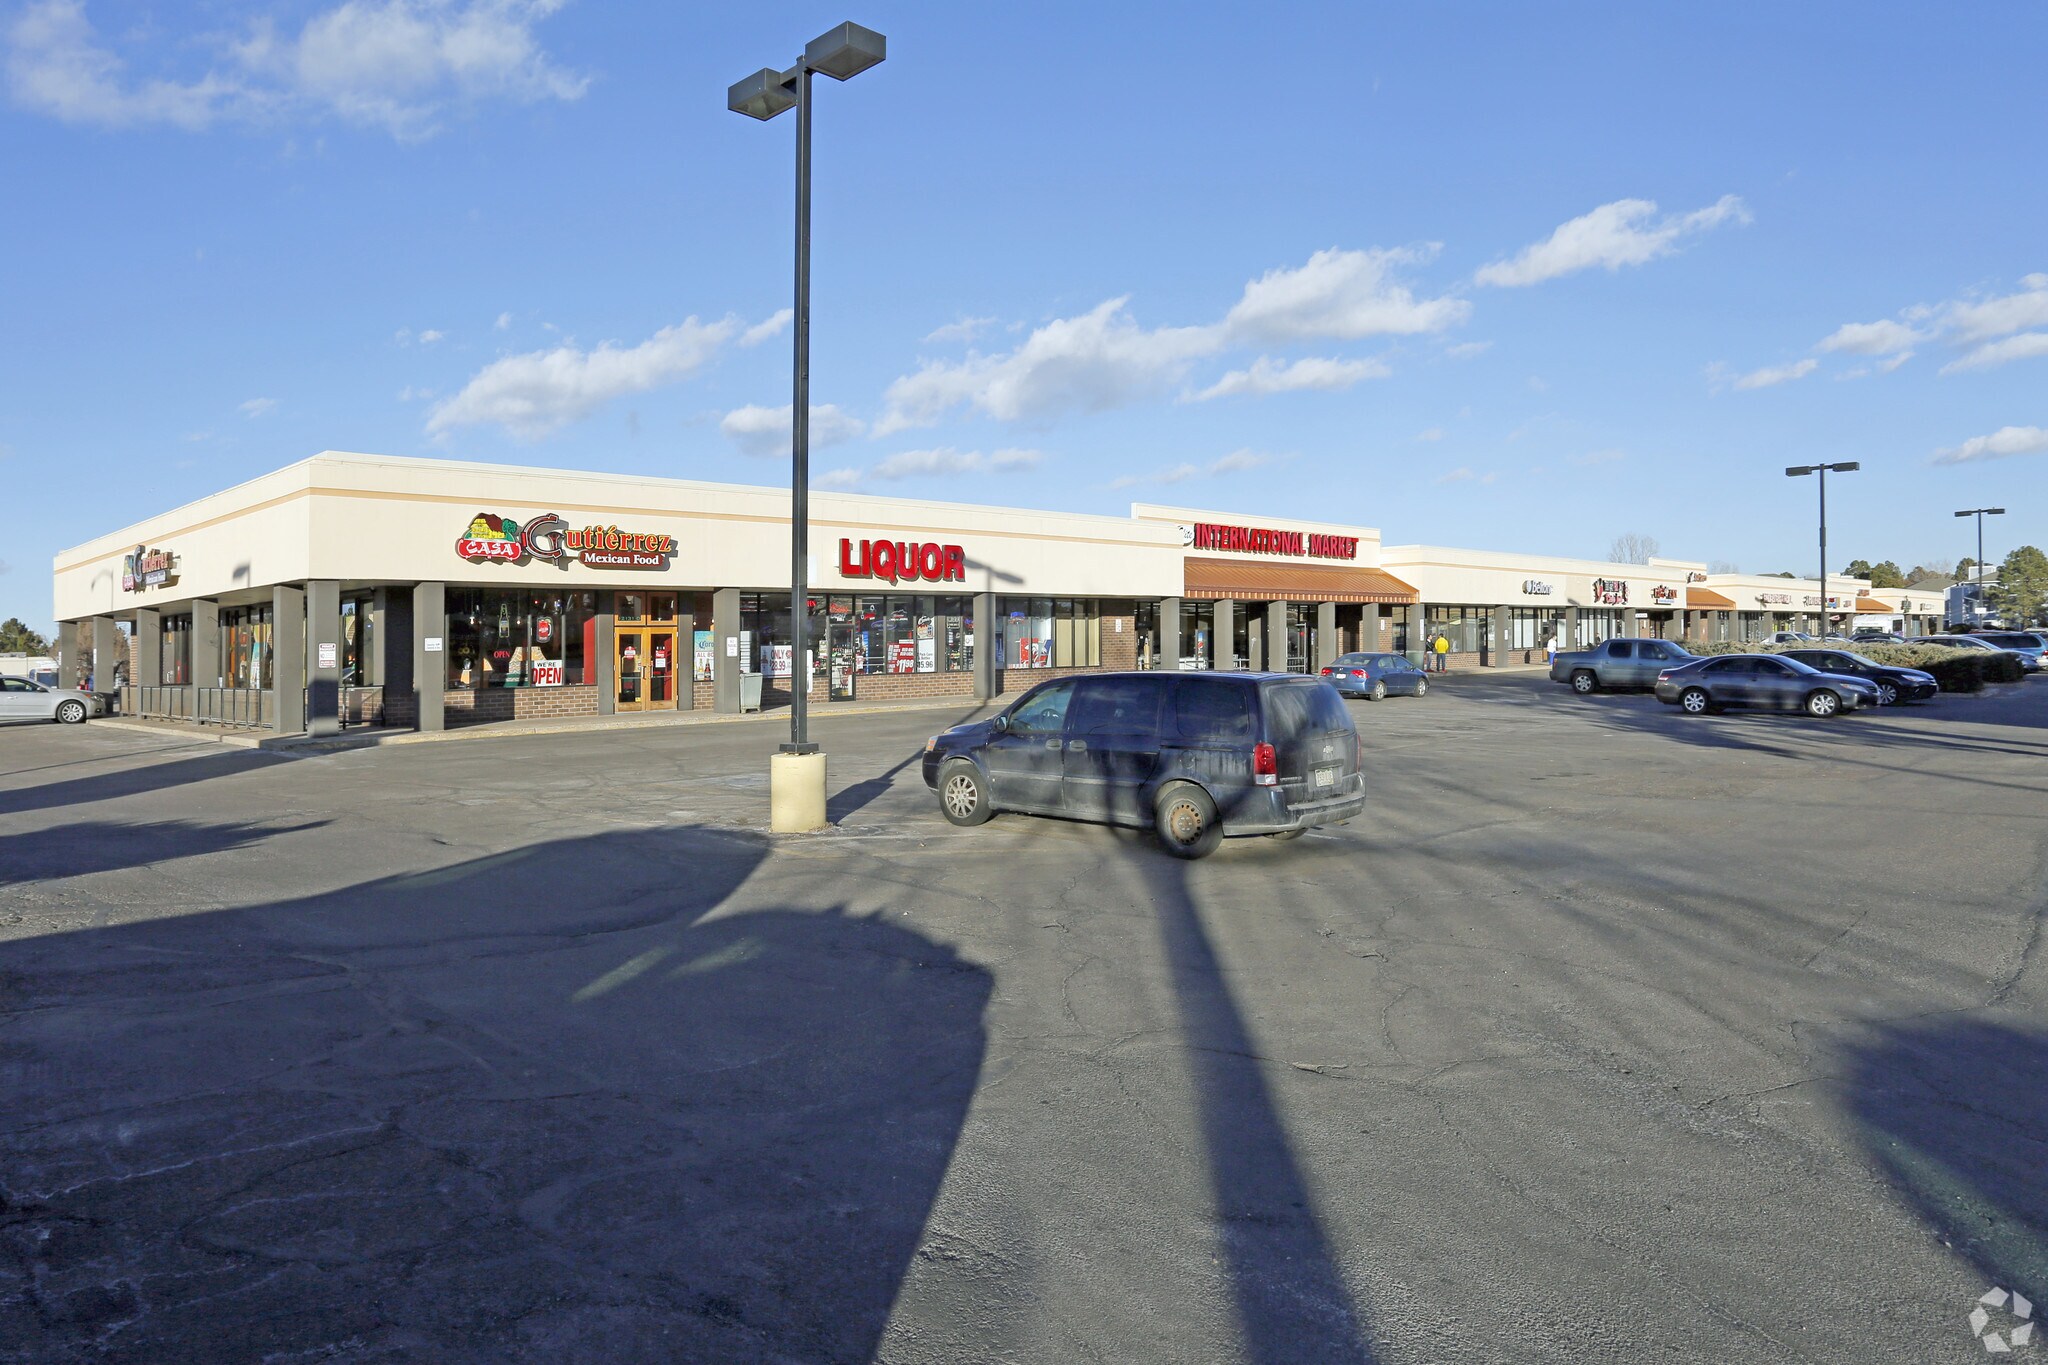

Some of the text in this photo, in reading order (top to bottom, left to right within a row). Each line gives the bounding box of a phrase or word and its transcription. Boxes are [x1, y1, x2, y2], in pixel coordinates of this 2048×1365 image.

[466, 513, 671, 567] CASA Gutiérrez
[1195, 523, 1359, 559] INTERNATIONAL MARKET
[584, 552, 660, 565] Mexican Food
[839, 538, 965, 586] LIQUOR
[493, 651, 511, 659] OPEN
[532, 668, 562, 684] OPEN
